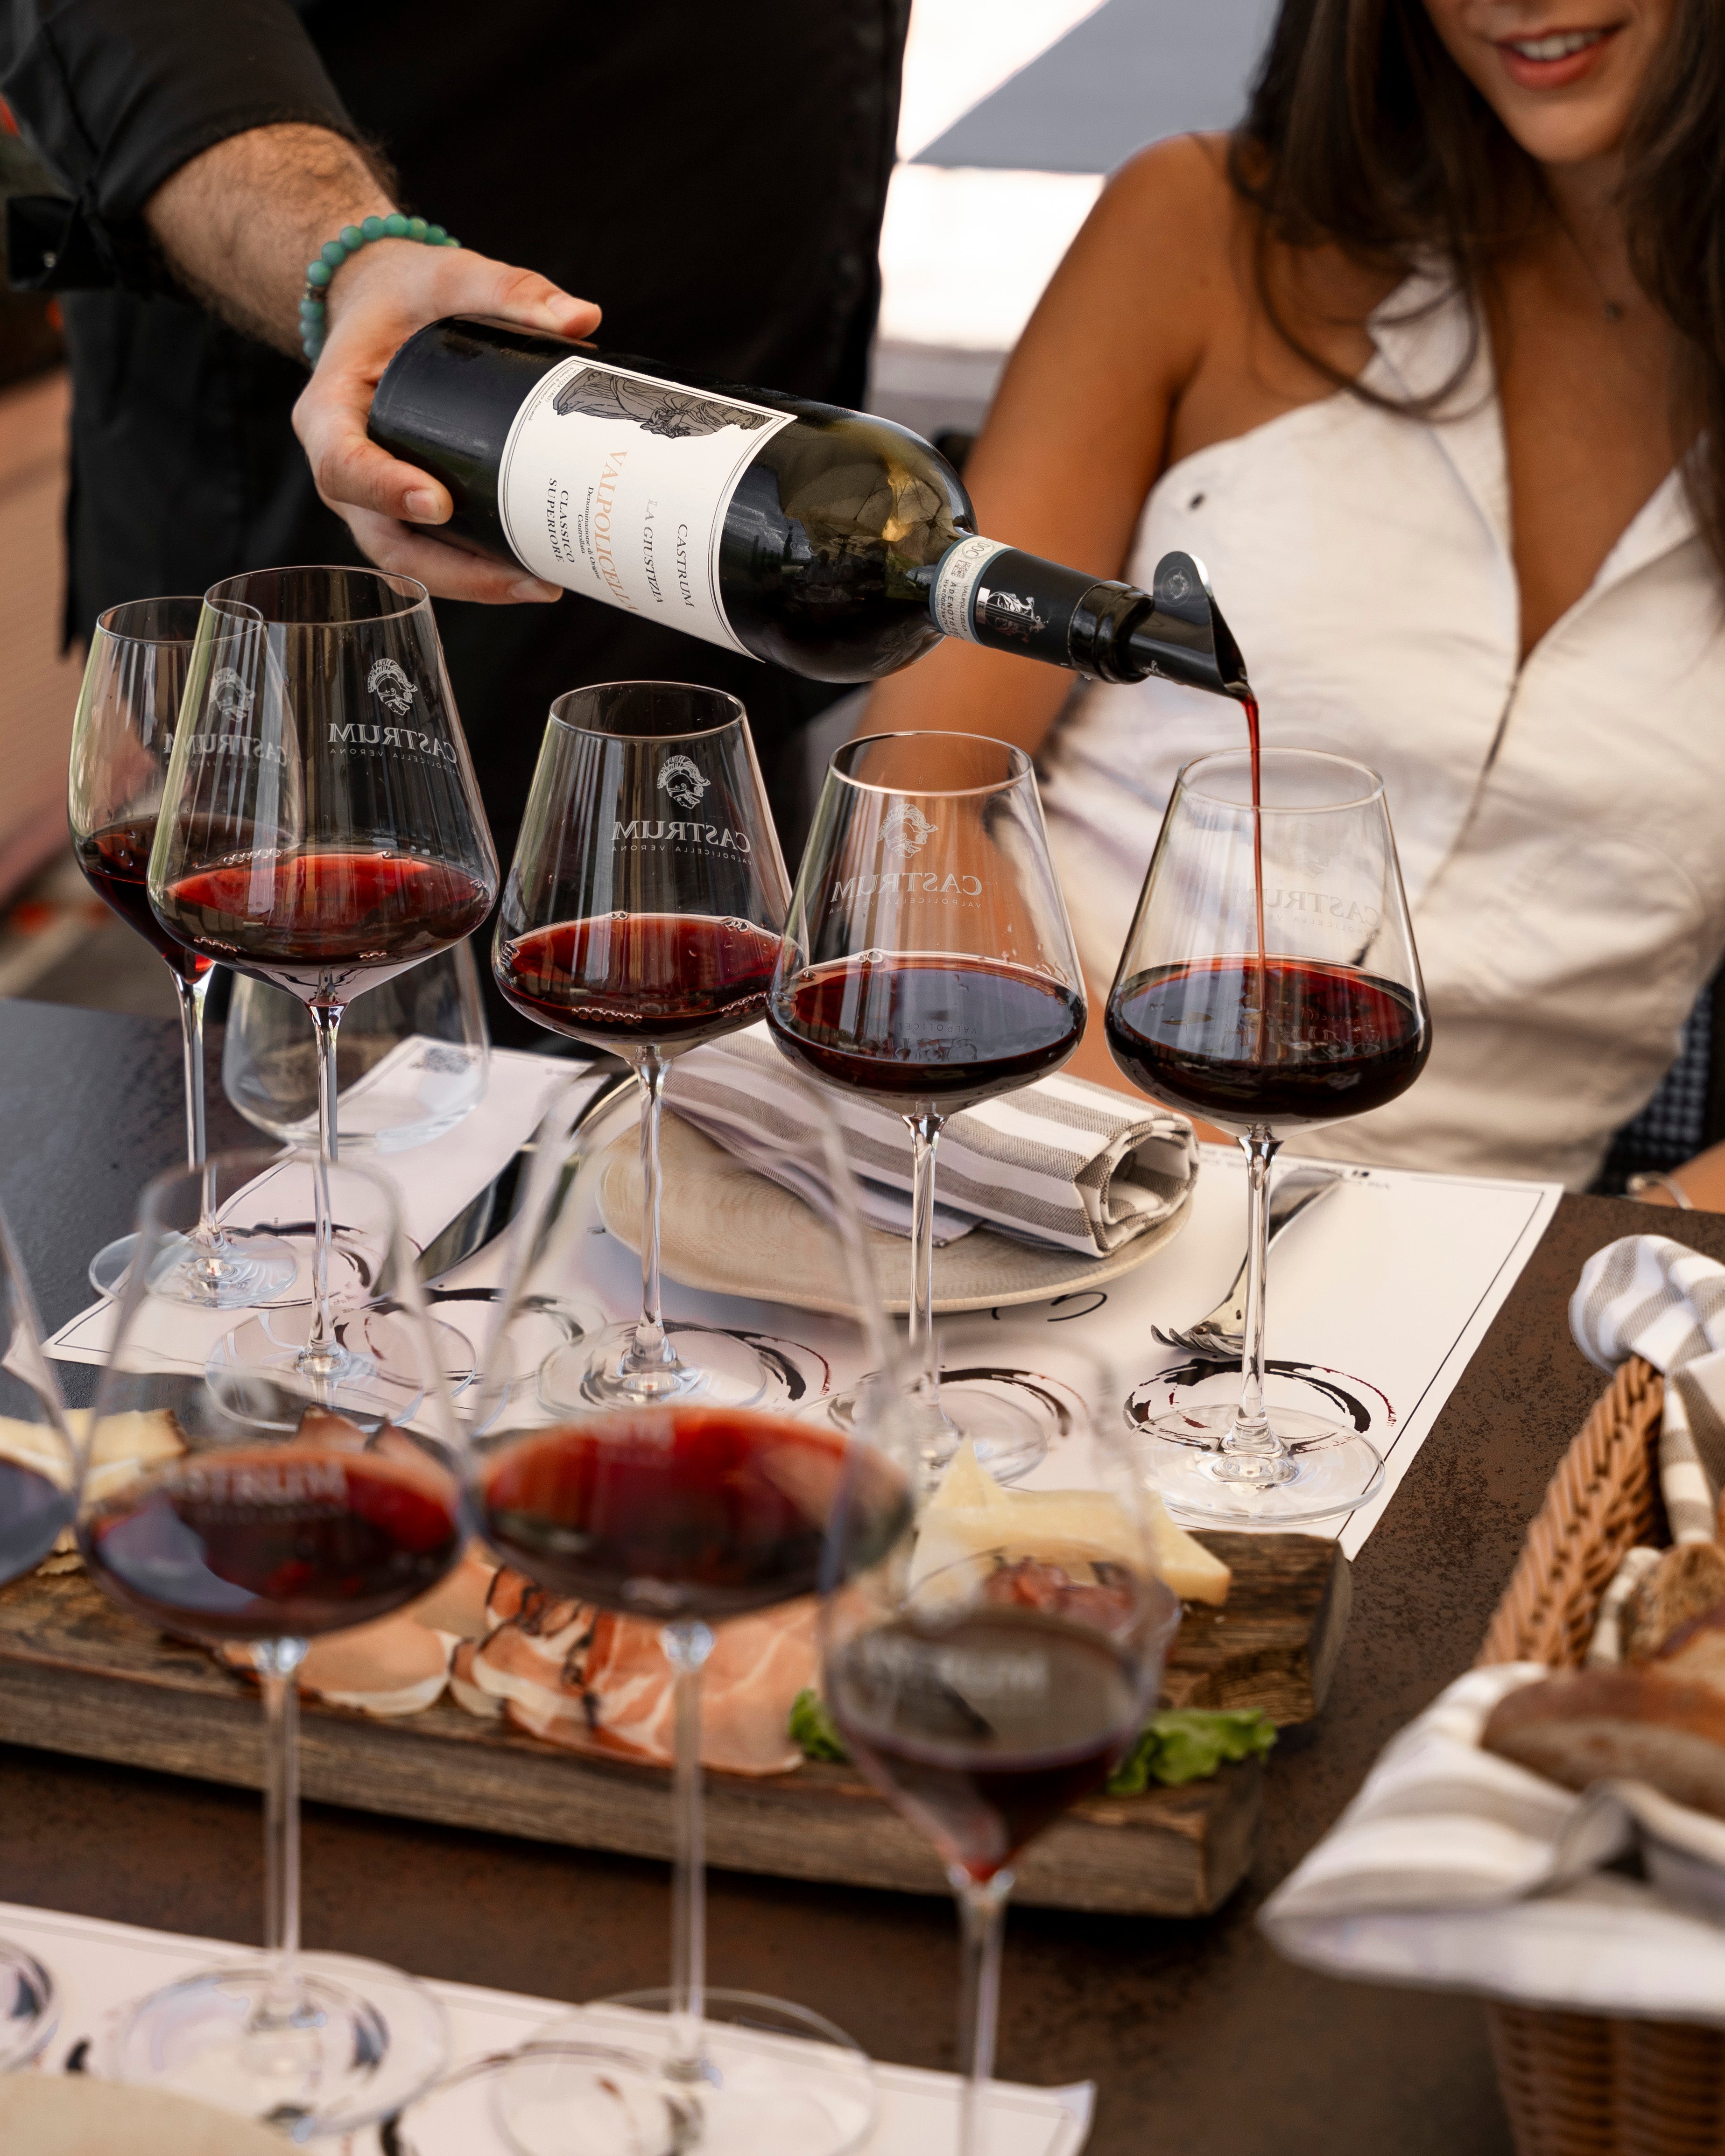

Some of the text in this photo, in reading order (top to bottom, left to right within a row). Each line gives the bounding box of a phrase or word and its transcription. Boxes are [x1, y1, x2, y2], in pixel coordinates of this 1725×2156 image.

[547, 478, 564, 562] SUPERIORE
[560, 490, 575, 563] CLASSICO
[585, 487, 601, 580] Denominazione di Origine
[594, 450, 639, 611] VALPOLICELLA
[643, 499, 664, 603] LA GIUSTIZIA
[966, 542, 990, 556] DOC
[677, 524, 695, 608] CASTRUM
[960, 585, 969, 632] VALPOLICELLA
